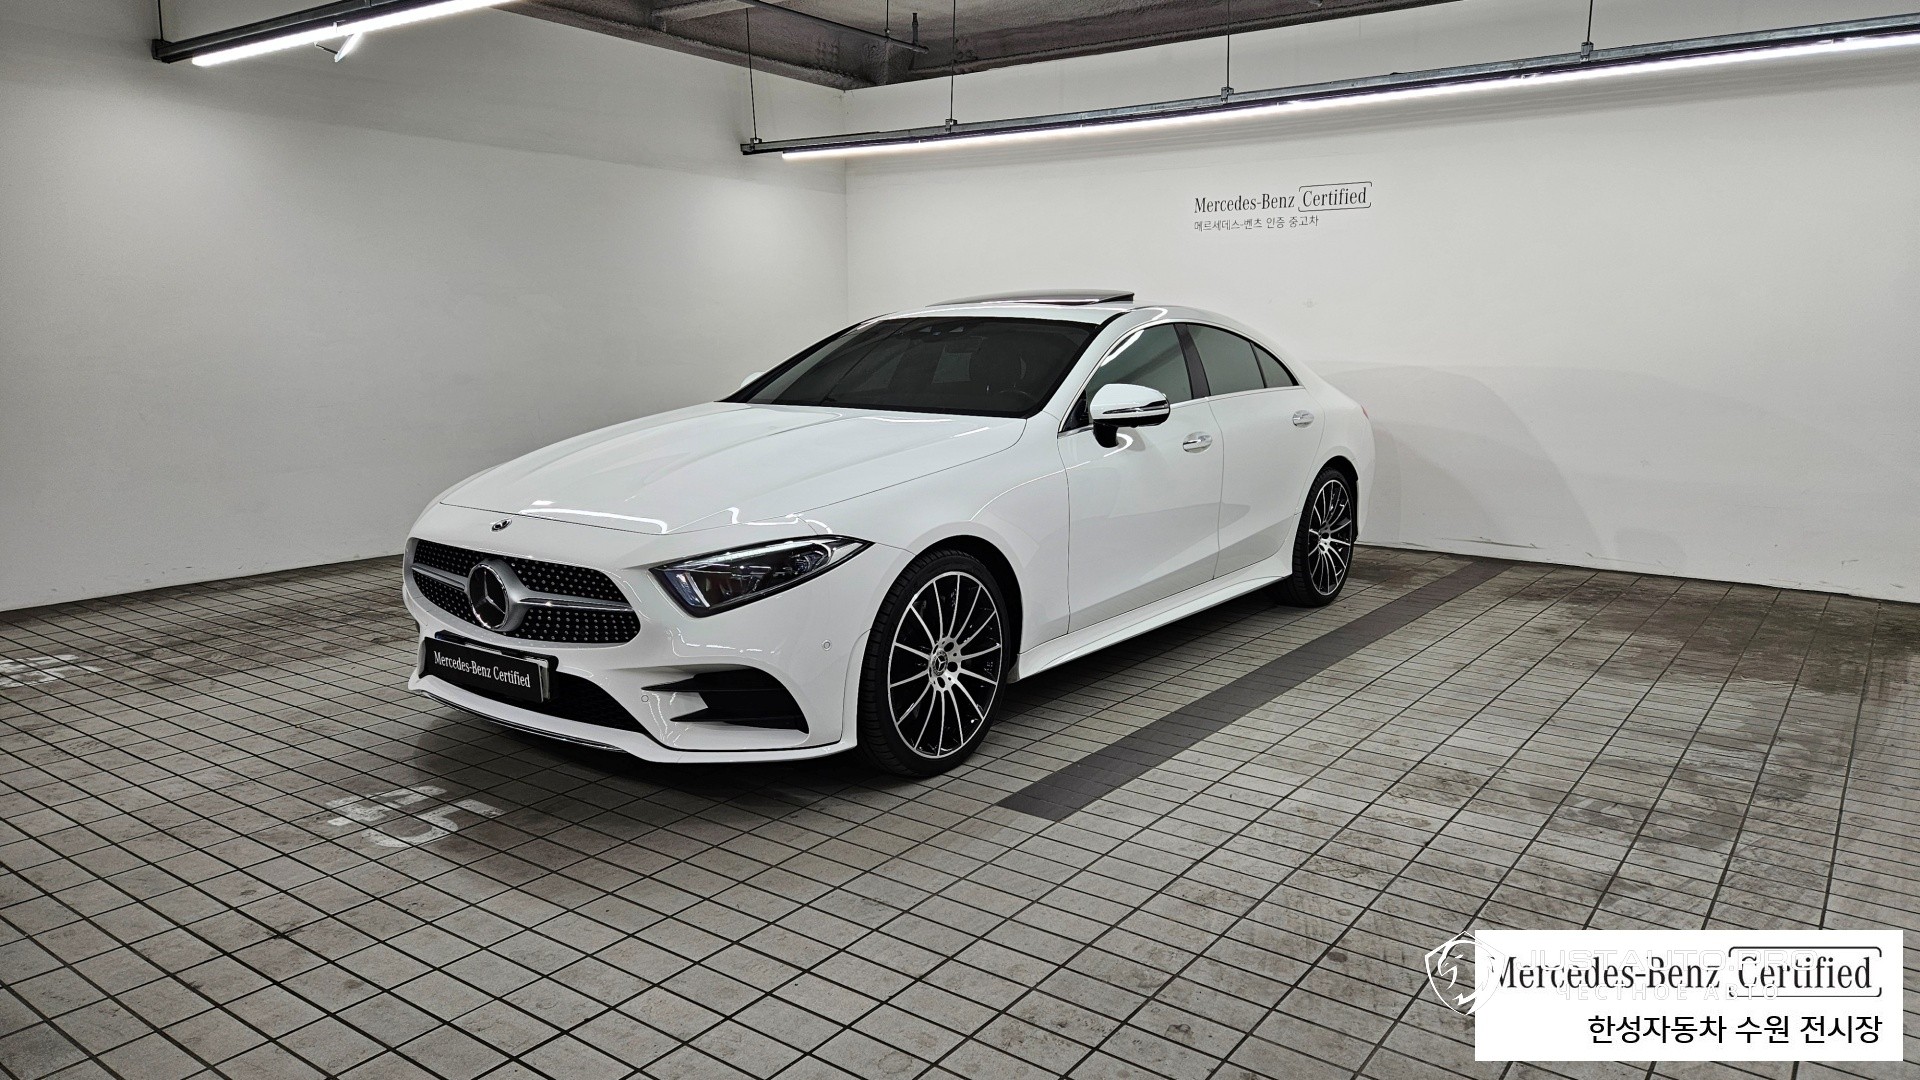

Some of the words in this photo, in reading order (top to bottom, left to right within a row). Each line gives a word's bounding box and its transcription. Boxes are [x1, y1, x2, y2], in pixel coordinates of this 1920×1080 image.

[1194, 193, 1295, 214] Mercedes-Benz
[1302, 186, 1367, 208] Certified
[1194, 218, 1263, 232] 메르세데스-벤츠
[1266, 217, 1285, 229] 인증
[1289, 215, 1319, 228] 중고차
[433, 651, 492, 679] Mercedes-Benz
[493, 666, 531, 688] Certified
